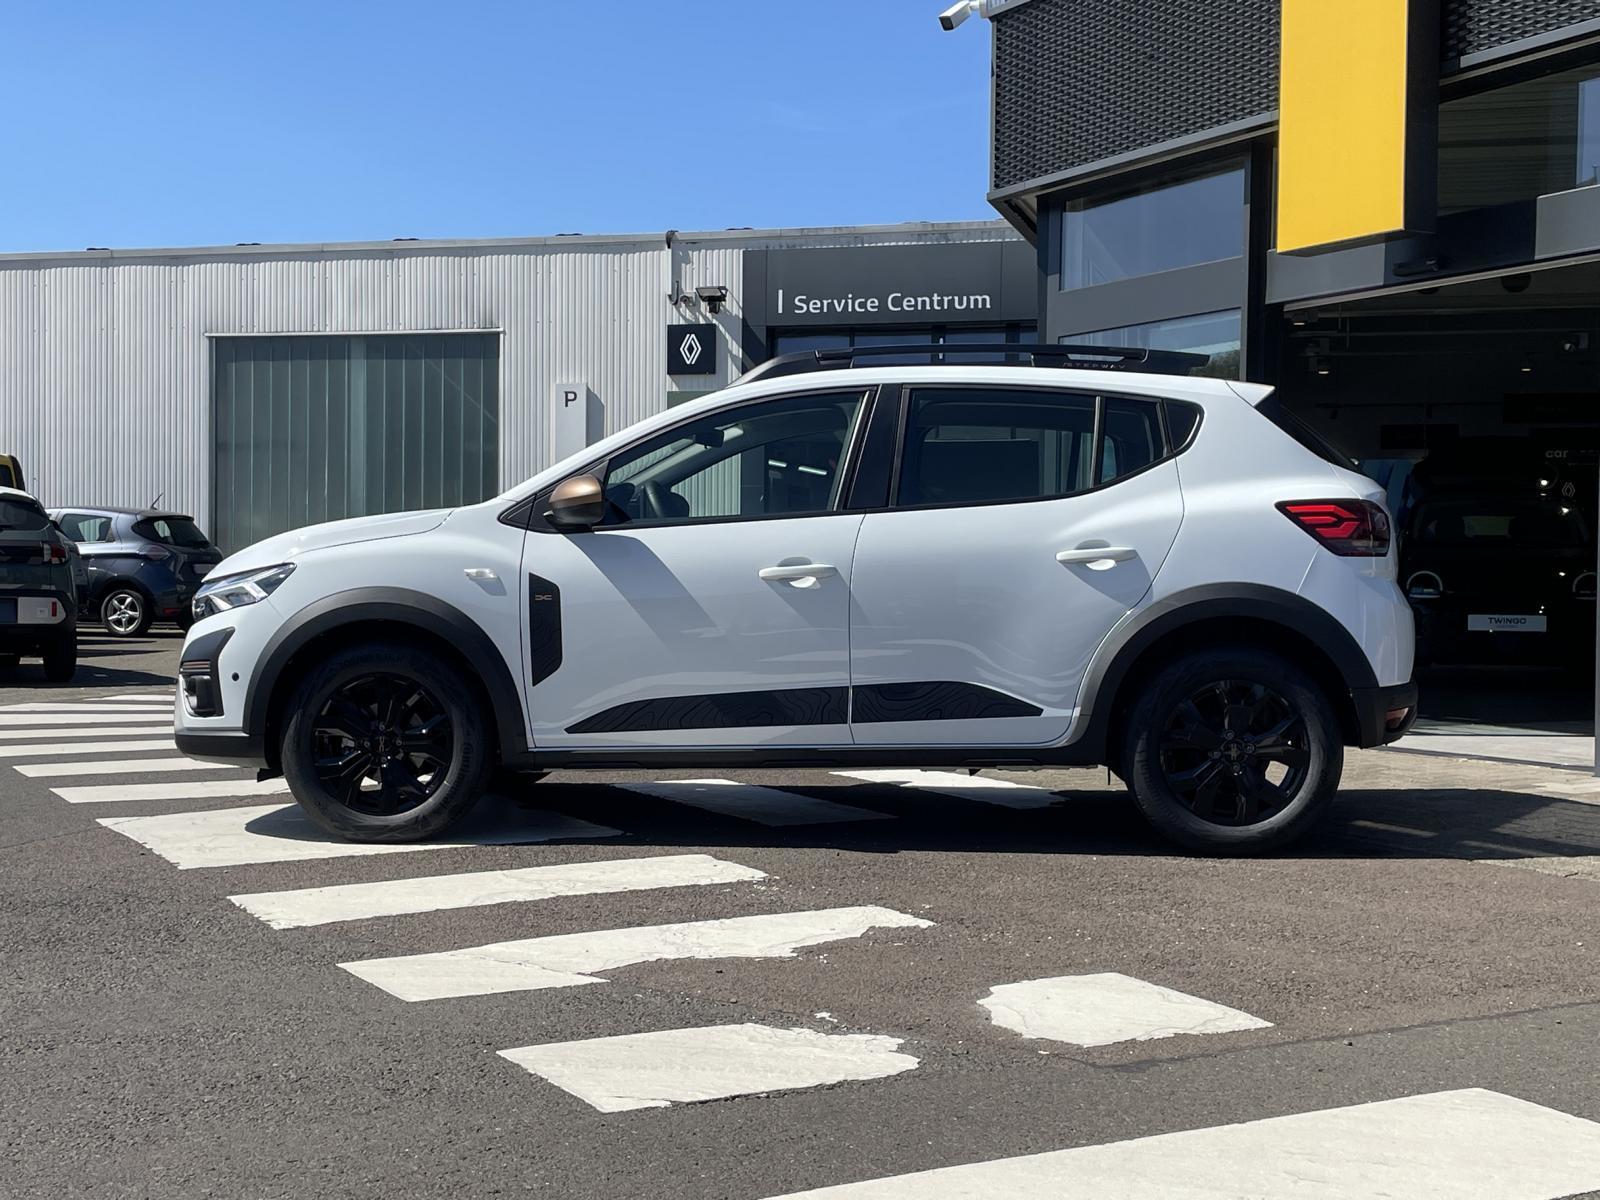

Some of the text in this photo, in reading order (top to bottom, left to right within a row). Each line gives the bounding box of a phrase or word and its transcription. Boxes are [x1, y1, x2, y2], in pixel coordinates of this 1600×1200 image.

[794, 293, 991, 313] Service Centrum
[563, 390, 578, 408] P
